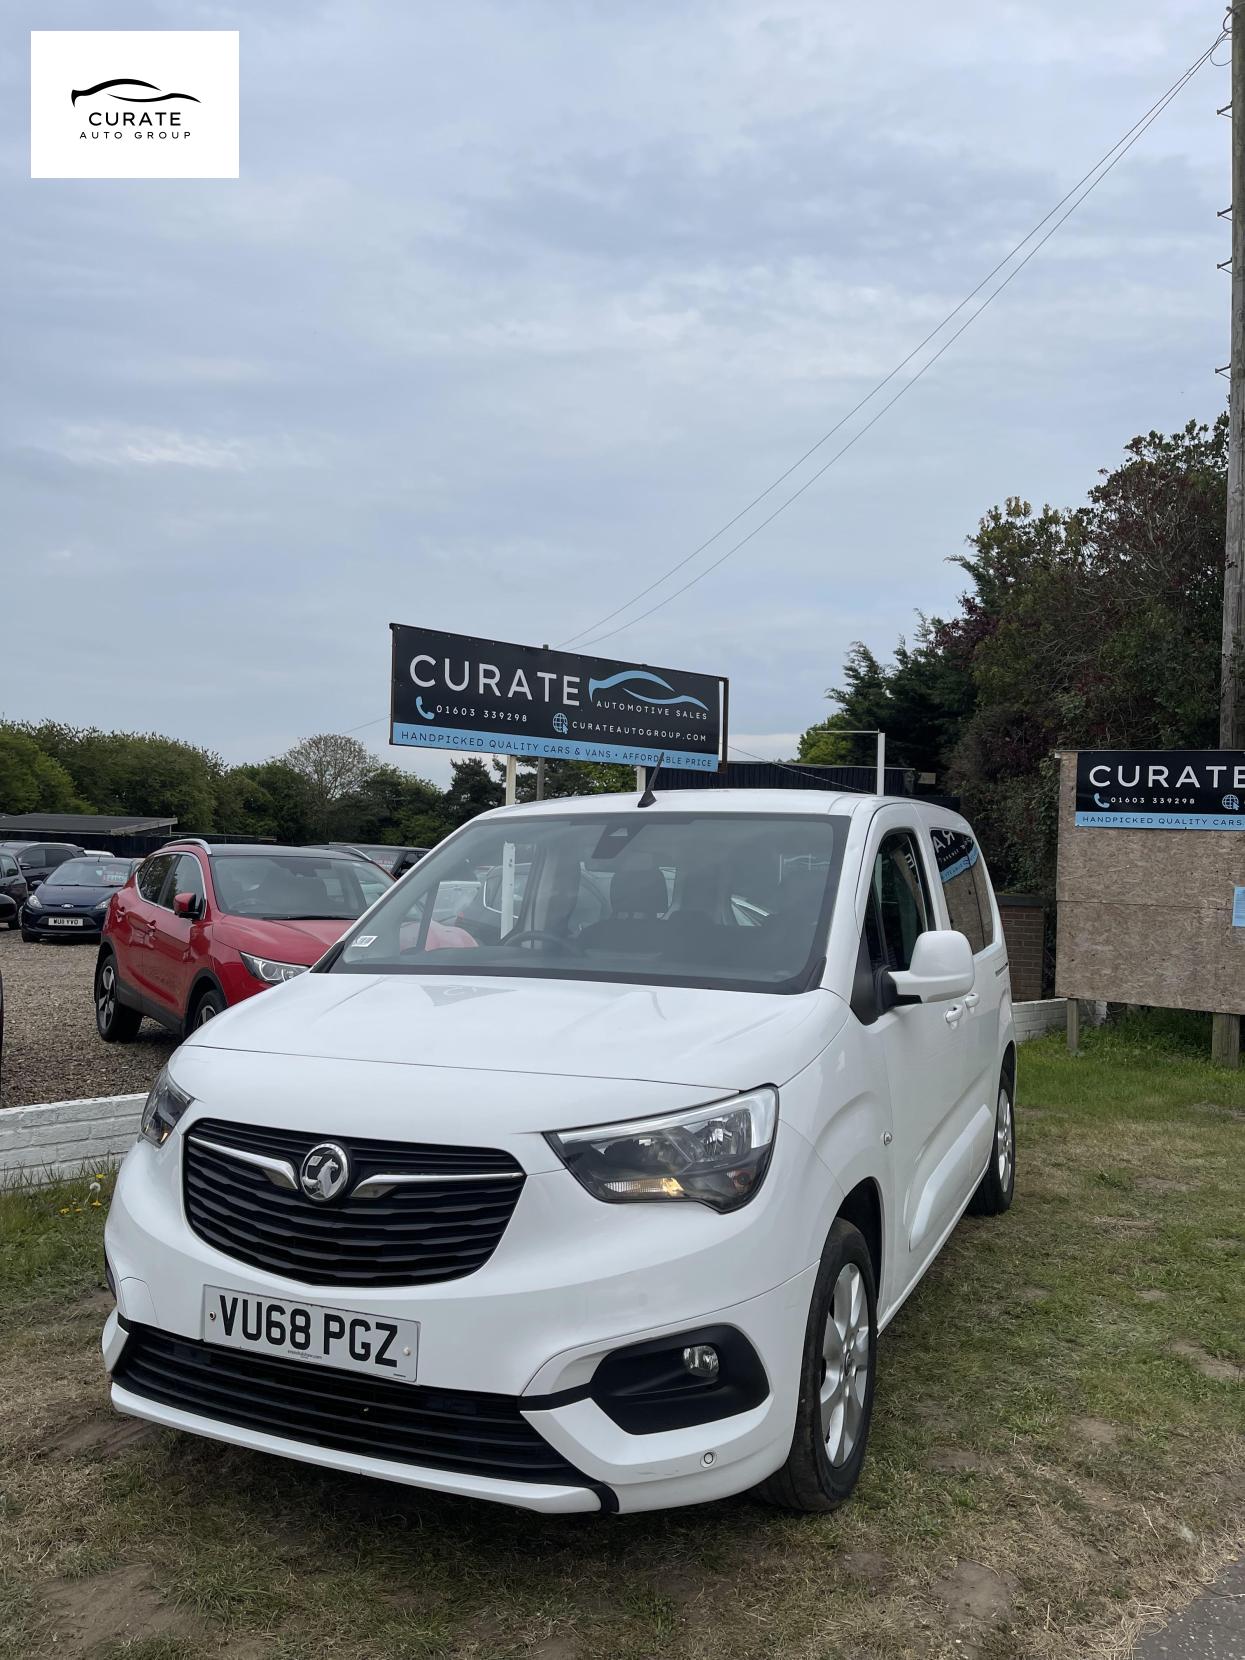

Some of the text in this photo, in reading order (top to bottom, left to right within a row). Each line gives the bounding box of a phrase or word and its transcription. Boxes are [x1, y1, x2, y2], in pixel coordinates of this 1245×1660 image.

[409, 654, 580, 706] CURATE
[436, 704, 527, 722] 01603 339298
[596, 700, 707, 720] AUTOMOTIVE SALES
[572, 721, 706, 742] CURATEAUTOGROUP.COM
[401, 731, 484, 747] HANDPICKED
[489, 739, 539, 751] QUALITY
[543, 744, 570, 755] CARS
[574, 747, 581, 755] &
[585, 749, 611, 758] VANS
[685, 757, 712, 767] PRICE
[1089, 765, 1245, 788] CURATE
[1110, 796, 1195, 805] 01603 339298
[1082, 816, 1153, 824] HANDPICKED
[219, 1294, 398, 1368] VU68 PGZ
